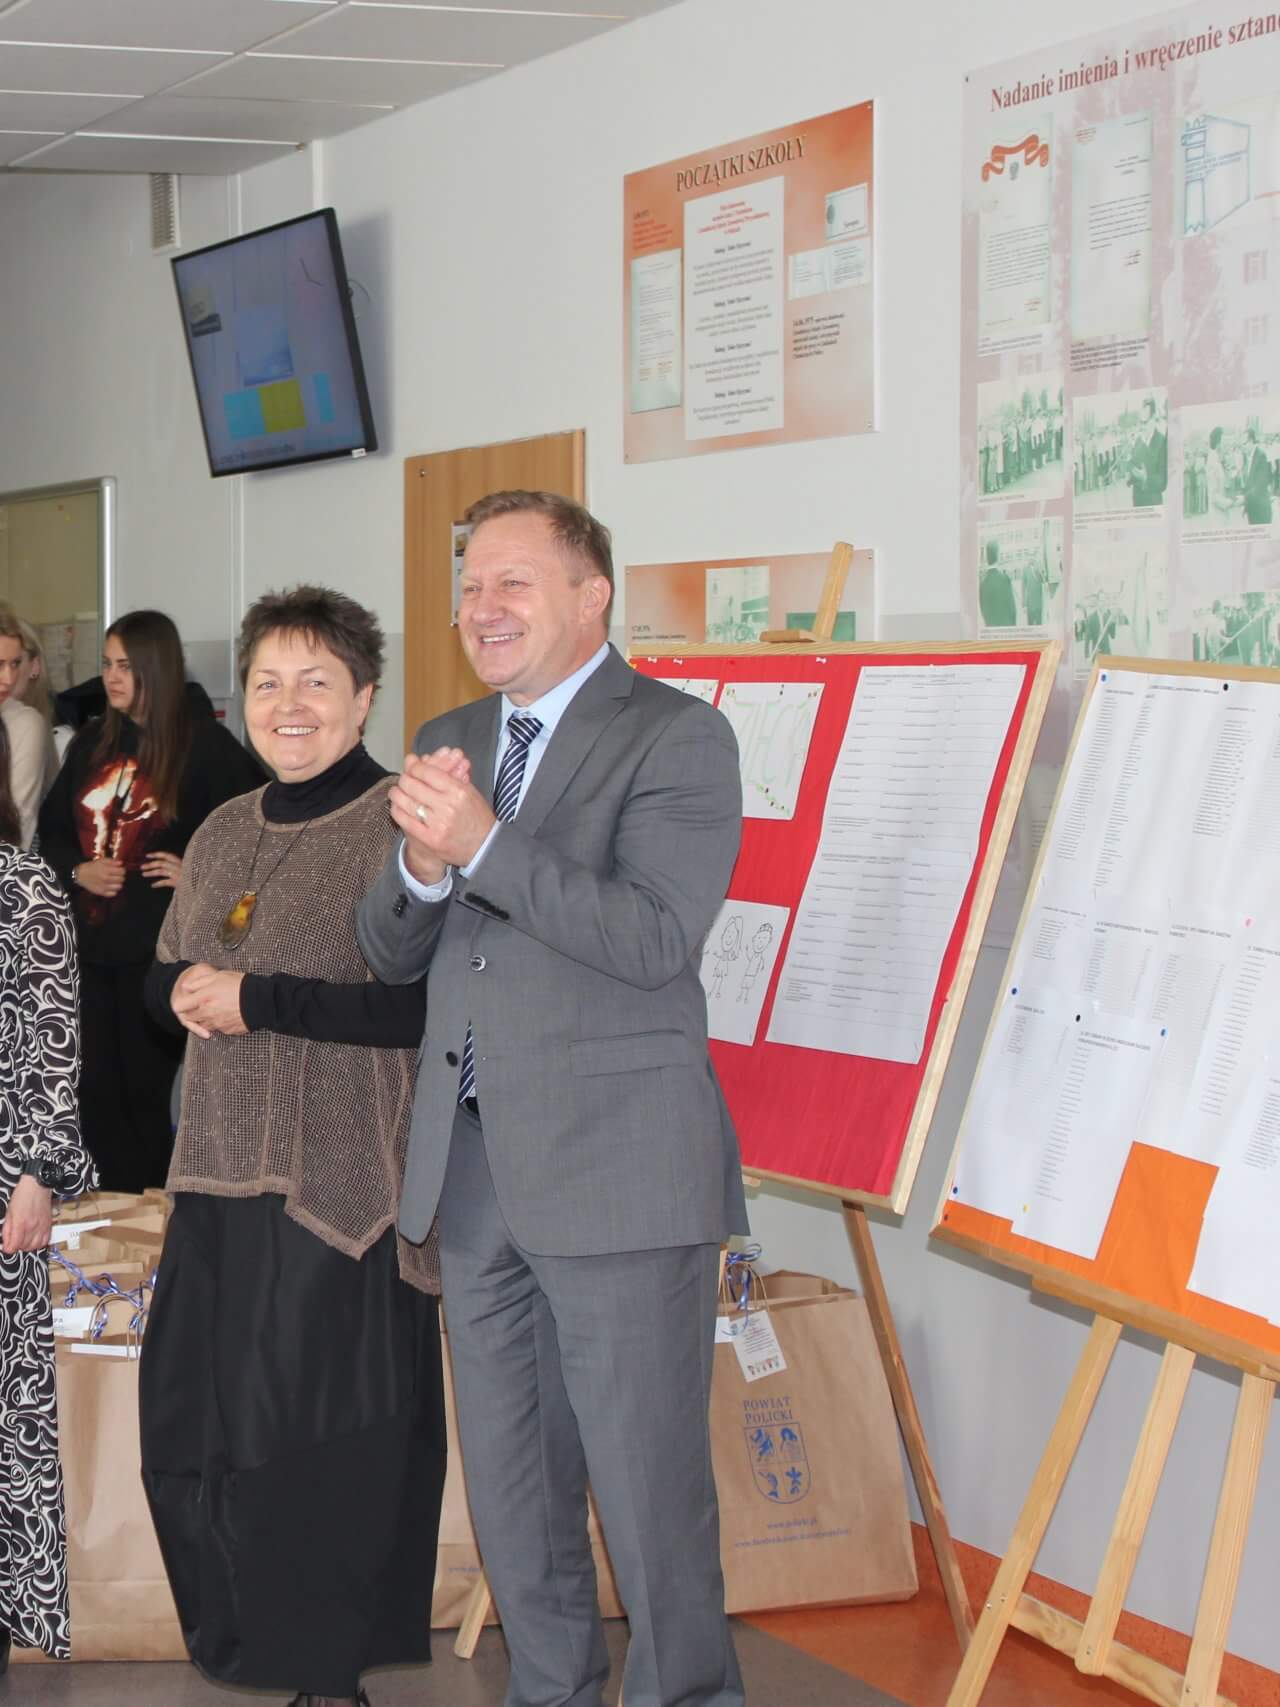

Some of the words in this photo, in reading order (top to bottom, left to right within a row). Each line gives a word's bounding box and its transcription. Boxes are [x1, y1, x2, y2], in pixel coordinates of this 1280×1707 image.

[991, 73, 1054, 112] Nadanie
[1058, 56, 1118, 92] imienia
[1123, 50, 1129, 74] i
[1135, 25, 1222, 71] wręczenie
[676, 153, 745, 192] POCZĄTKI
[748, 135, 807, 172] SZKOŁY
[743, 1396, 791, 1411] POWIAT
[745, 1409, 793, 1424] POLICKI
